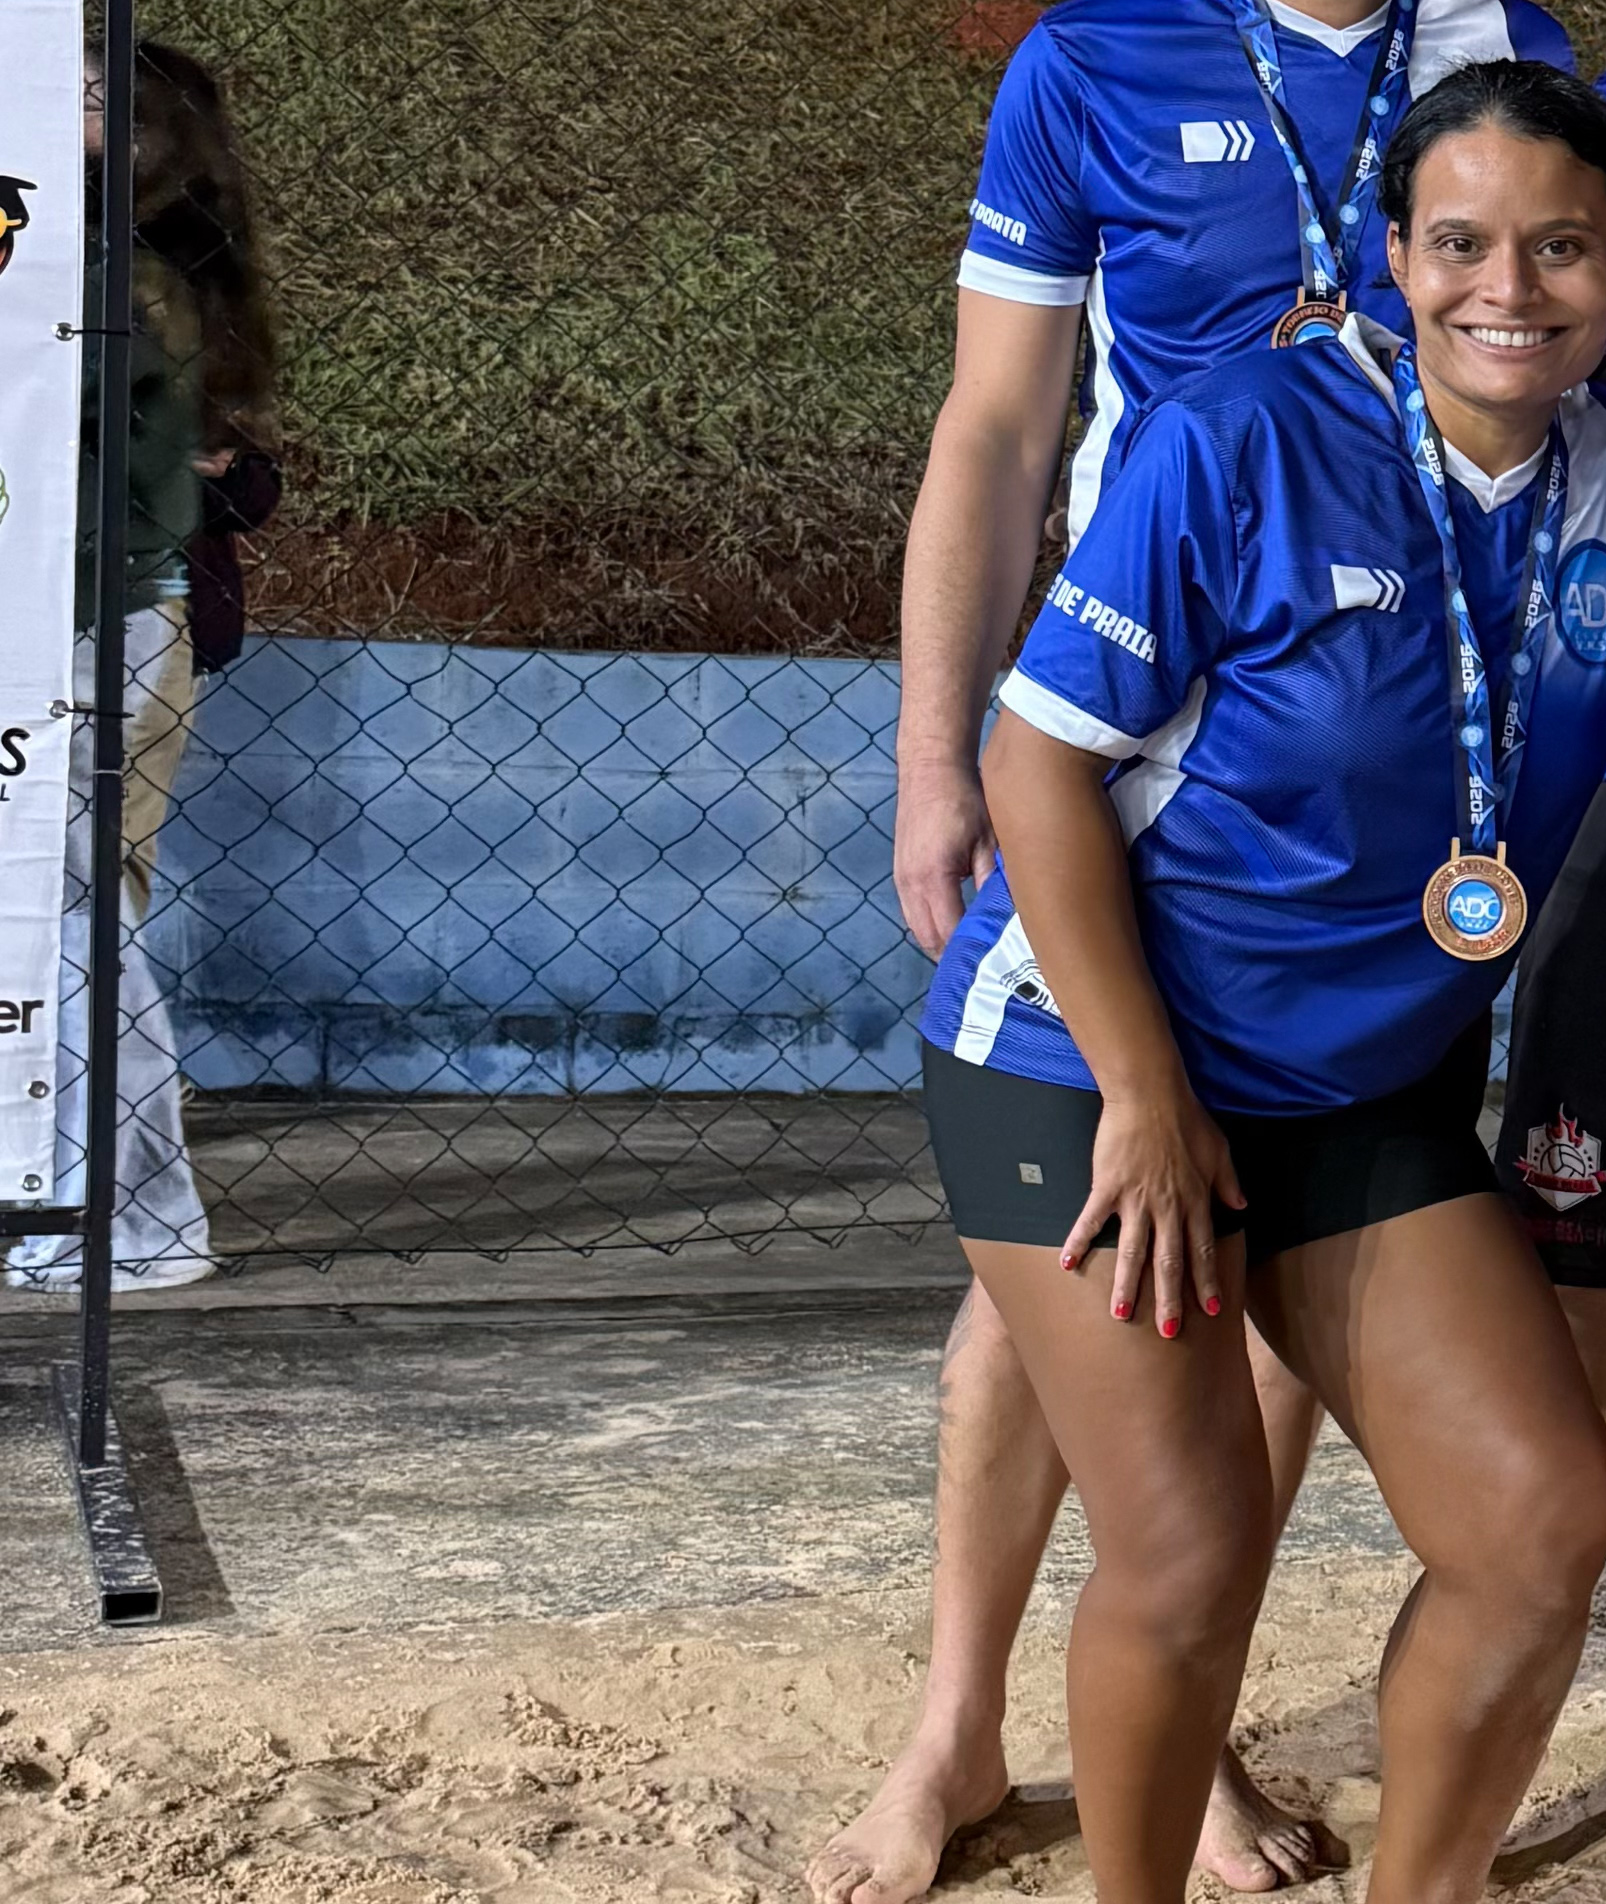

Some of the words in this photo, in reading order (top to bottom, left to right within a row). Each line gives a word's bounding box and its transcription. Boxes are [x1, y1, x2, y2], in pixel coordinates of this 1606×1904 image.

[1385, 28, 1405, 71] 2026
[1356, 137, 1377, 180] 2026
[1421, 436, 1445, 486] 2026
[1525, 578, 1544, 628] 2026
[1078, 595, 1158, 664] PRAIA
[1459, 643, 1476, 694] 2026
[1501, 700, 1519, 750] 2026
[1468, 775, 1485, 826] 2026
[1449, 895, 1501, 921] ADC
